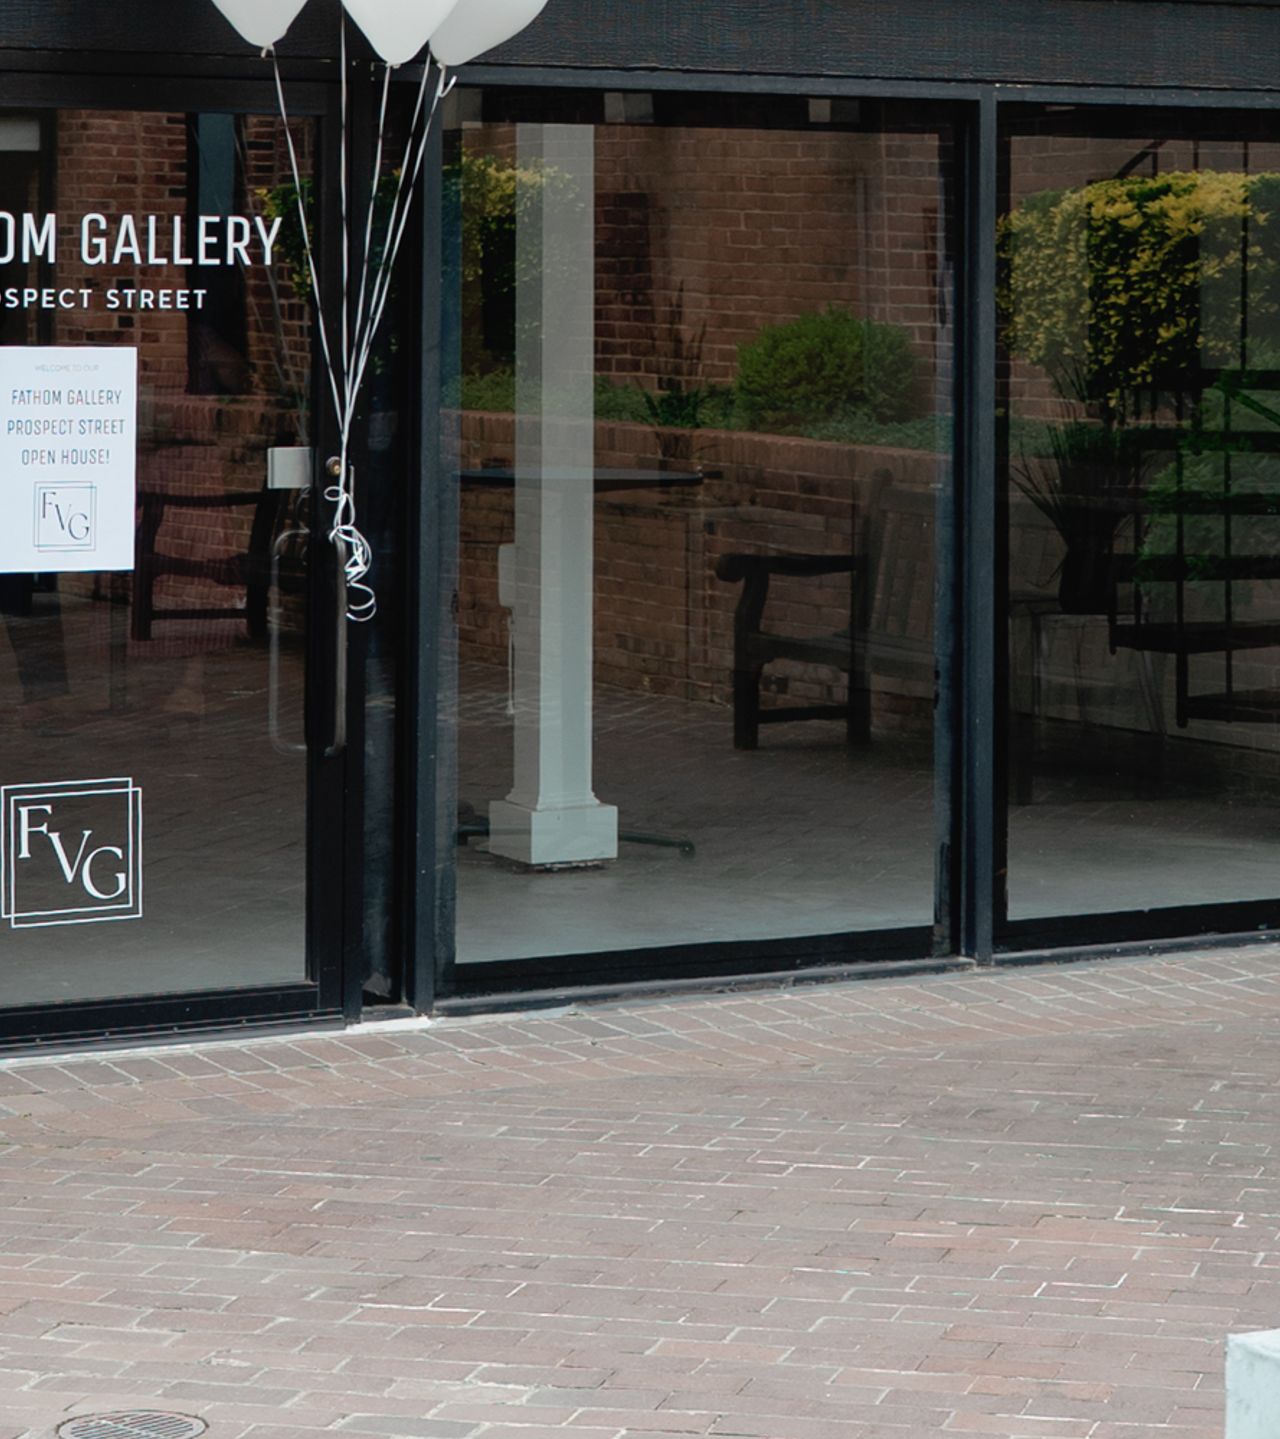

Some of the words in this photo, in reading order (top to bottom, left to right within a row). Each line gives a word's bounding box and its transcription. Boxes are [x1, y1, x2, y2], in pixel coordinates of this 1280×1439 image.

[81, 213, 282, 267] GALLERY
[106, 288, 208, 310] STREET
[35, 364, 70, 372] WELCOME
[83, 364, 100, 372] OUR
[11, 389, 62, 406] FATHOM
[67, 389, 122, 406] GALLERY
[7, 419, 74, 436] PROSPECT
[78, 419, 126, 435] STREET
[21, 449, 56, 466] OPEN
[61, 448, 110, 465] HOUSE!
[41, 491, 90, 541] FVG
[18, 804, 127, 900] FVG
